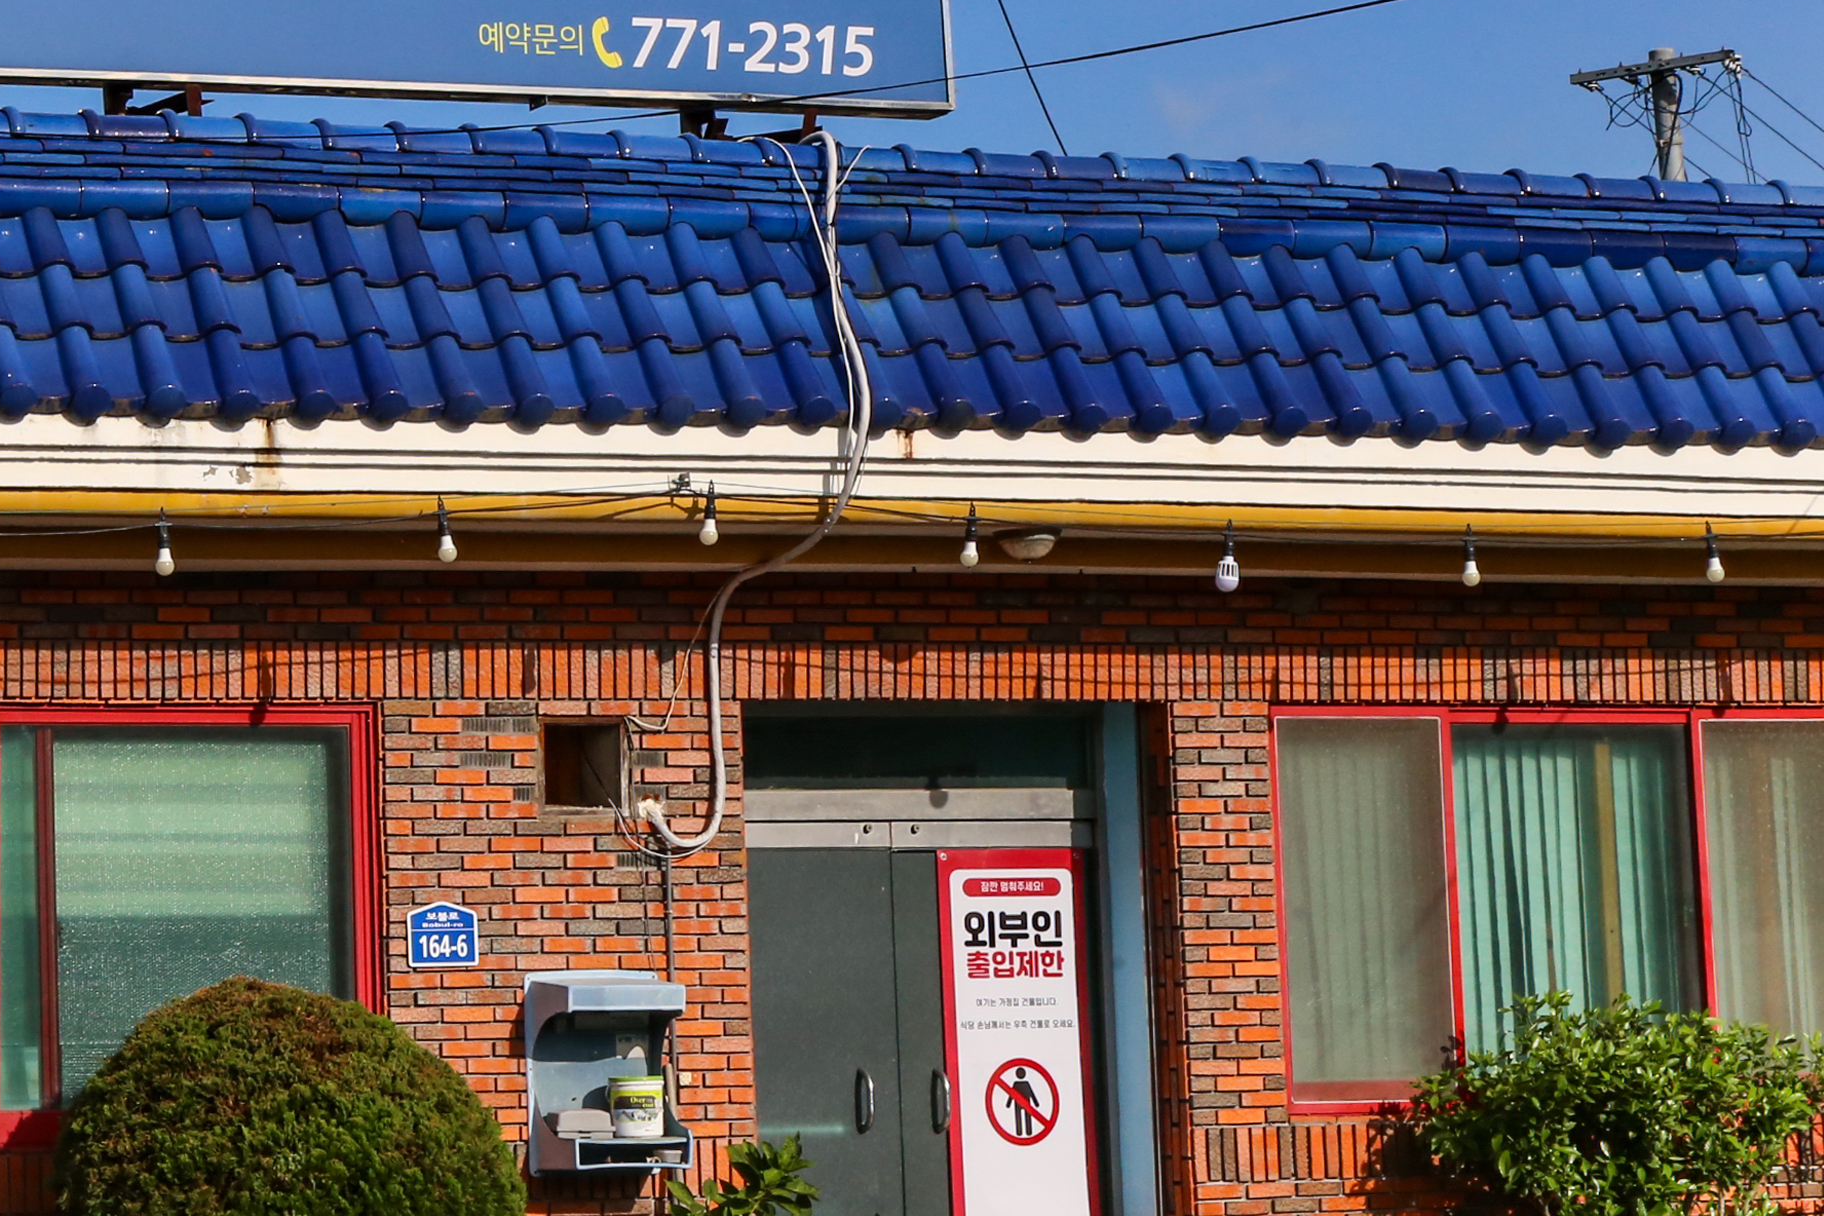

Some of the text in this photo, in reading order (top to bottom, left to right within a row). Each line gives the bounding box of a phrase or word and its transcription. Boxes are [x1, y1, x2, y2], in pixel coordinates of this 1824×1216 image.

[477, 16, 875, 77] 예약문의 771-2315
[980, 880, 1045, 893] 잠깐 멈춰주세요!
[963, 909, 1064, 949] 외부인
[418, 933, 469, 959] 164-6
[966, 949, 1066, 979] 출입제한
[975, 997, 997, 1007] 여기는
[998, 997, 1020, 1007] 가정집
[960, 1020, 975, 1030] 식당
[977, 1020, 1012, 1030] 손님께서는
[1029, 1019, 1051, 1029] 건물로
[629, 1096, 646, 1104] Over
